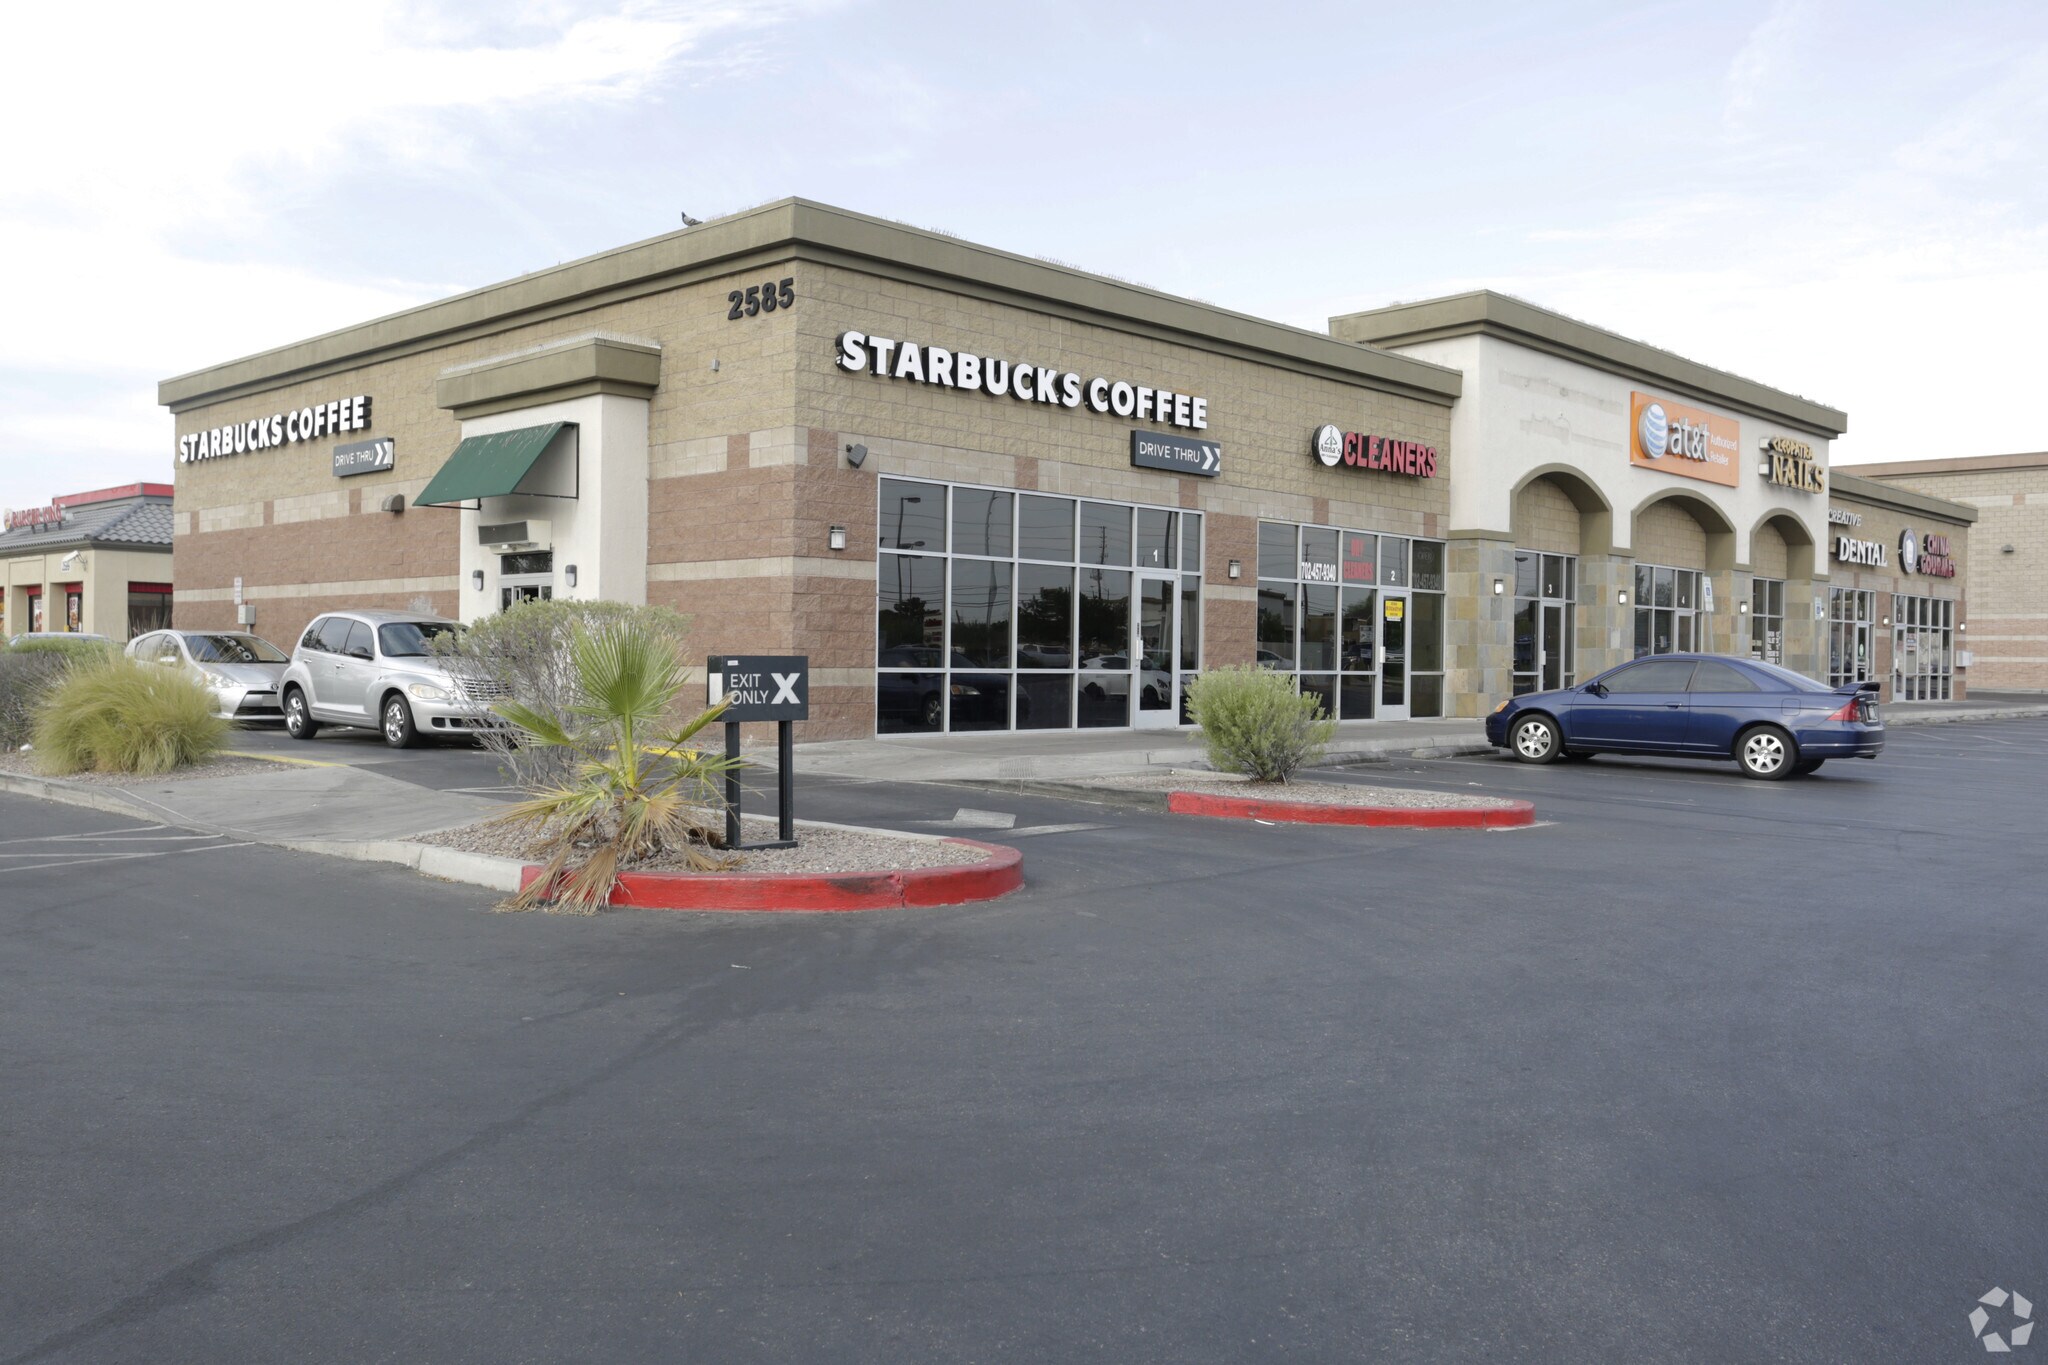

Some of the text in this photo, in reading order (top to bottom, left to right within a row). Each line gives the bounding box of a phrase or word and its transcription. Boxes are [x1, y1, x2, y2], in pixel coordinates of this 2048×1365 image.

[727, 277, 795, 320] 2585
[836, 330, 1208, 430] STARBUCKS COFFEE
[179, 395, 367, 463] STARBUCKS COFFEE
[1670, 418, 1710, 463] at&t
[335, 448, 374, 467] DRIVE THRU
[1139, 441, 1201, 464] DRIVE THRU
[1320, 443, 1341, 454] Anna's
[1344, 431, 1437, 478] CLEANERS
[1153, 549, 1158, 562] 1
[1839, 536, 1888, 567] DENTAL
[1927, 533, 1950, 556] CHINA
[1390, 570, 1396, 581] 2
[1920, 554, 1955, 579] GOURMET
[1548, 583, 1553, 594] 3
[730, 673, 762, 688] EXIT
[731, 690, 769, 705] ONLY
